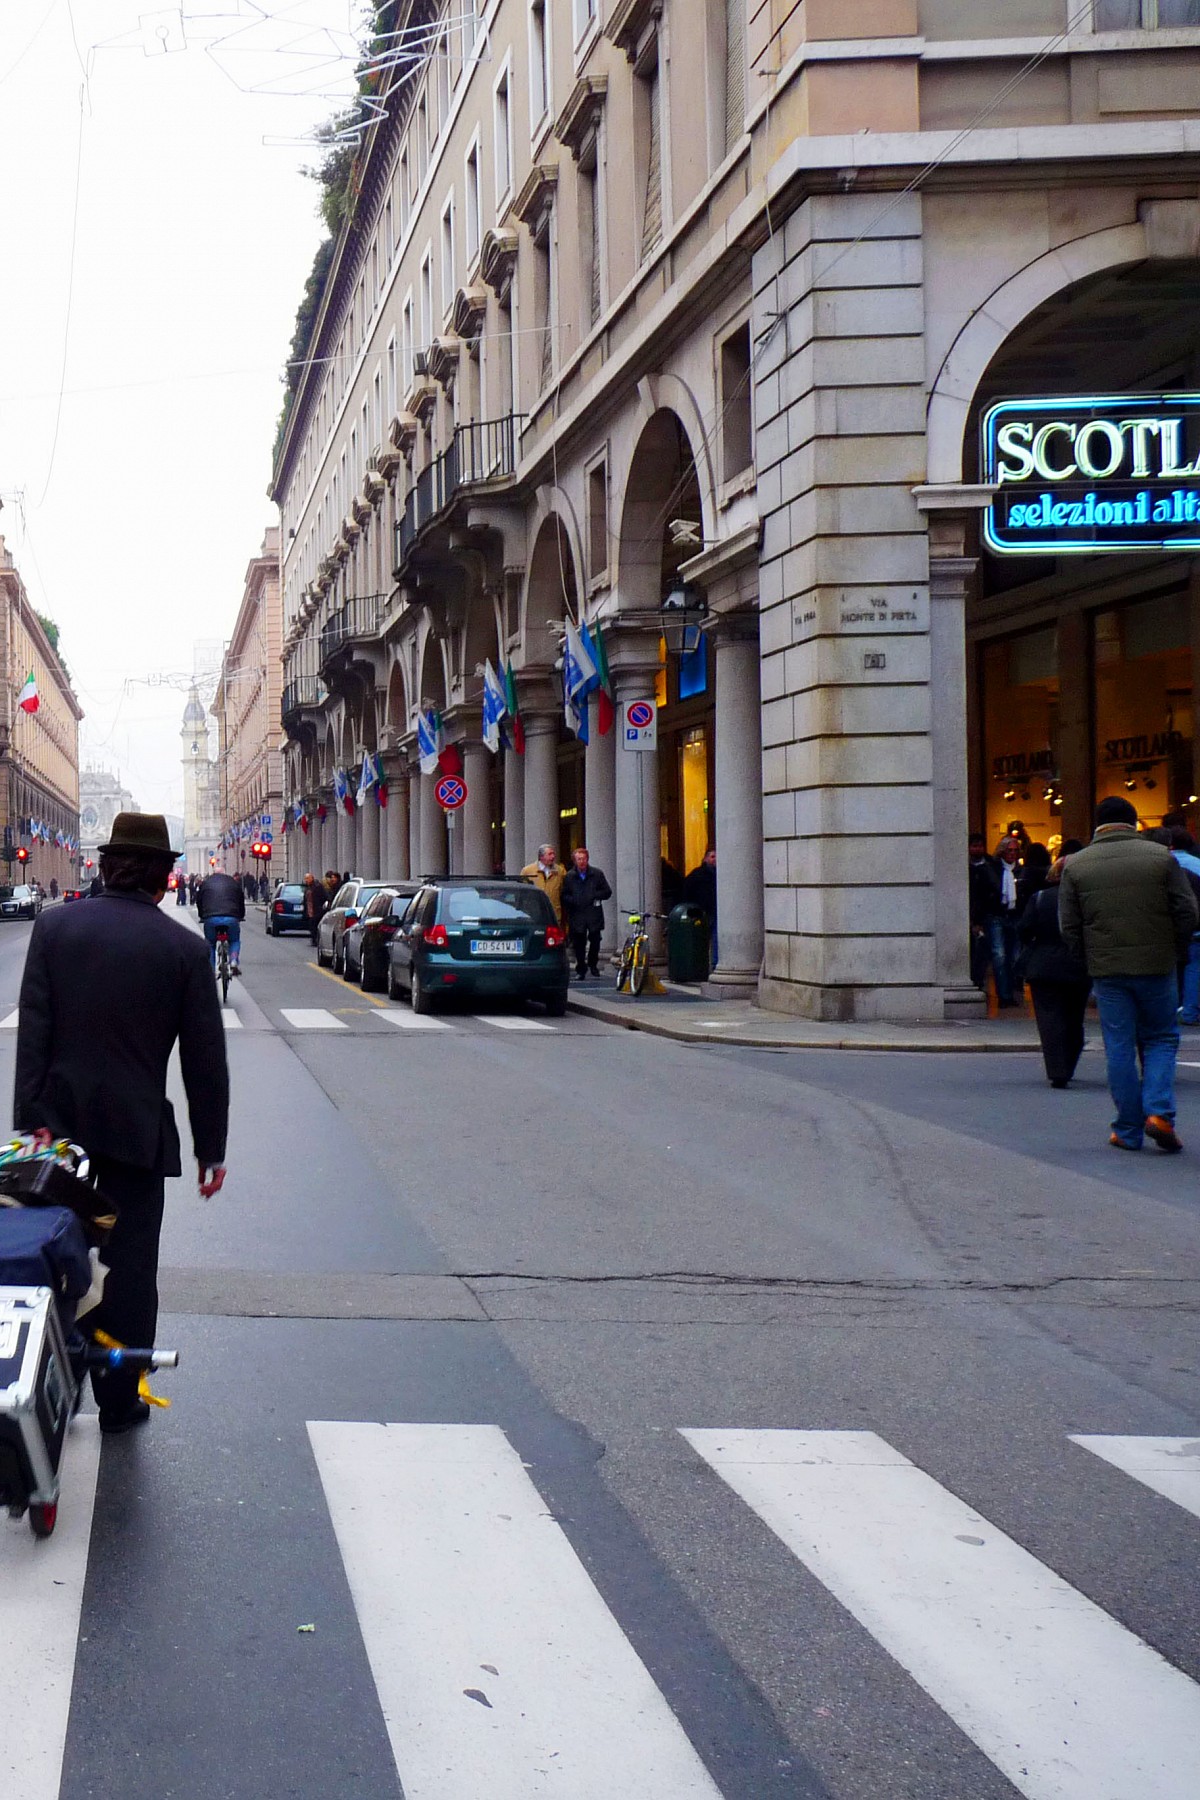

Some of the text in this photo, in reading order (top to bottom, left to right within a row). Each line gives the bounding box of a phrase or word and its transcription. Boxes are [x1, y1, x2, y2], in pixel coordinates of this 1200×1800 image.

[998, 420, 1200, 484] SCOTL
[1008, 492, 1149, 527] selezioni
[870, 598, 888, 608] VIA
[841, 612, 875, 623] MONTE
[878, 611, 887, 621] DI
[629, 730, 636, 739] P
